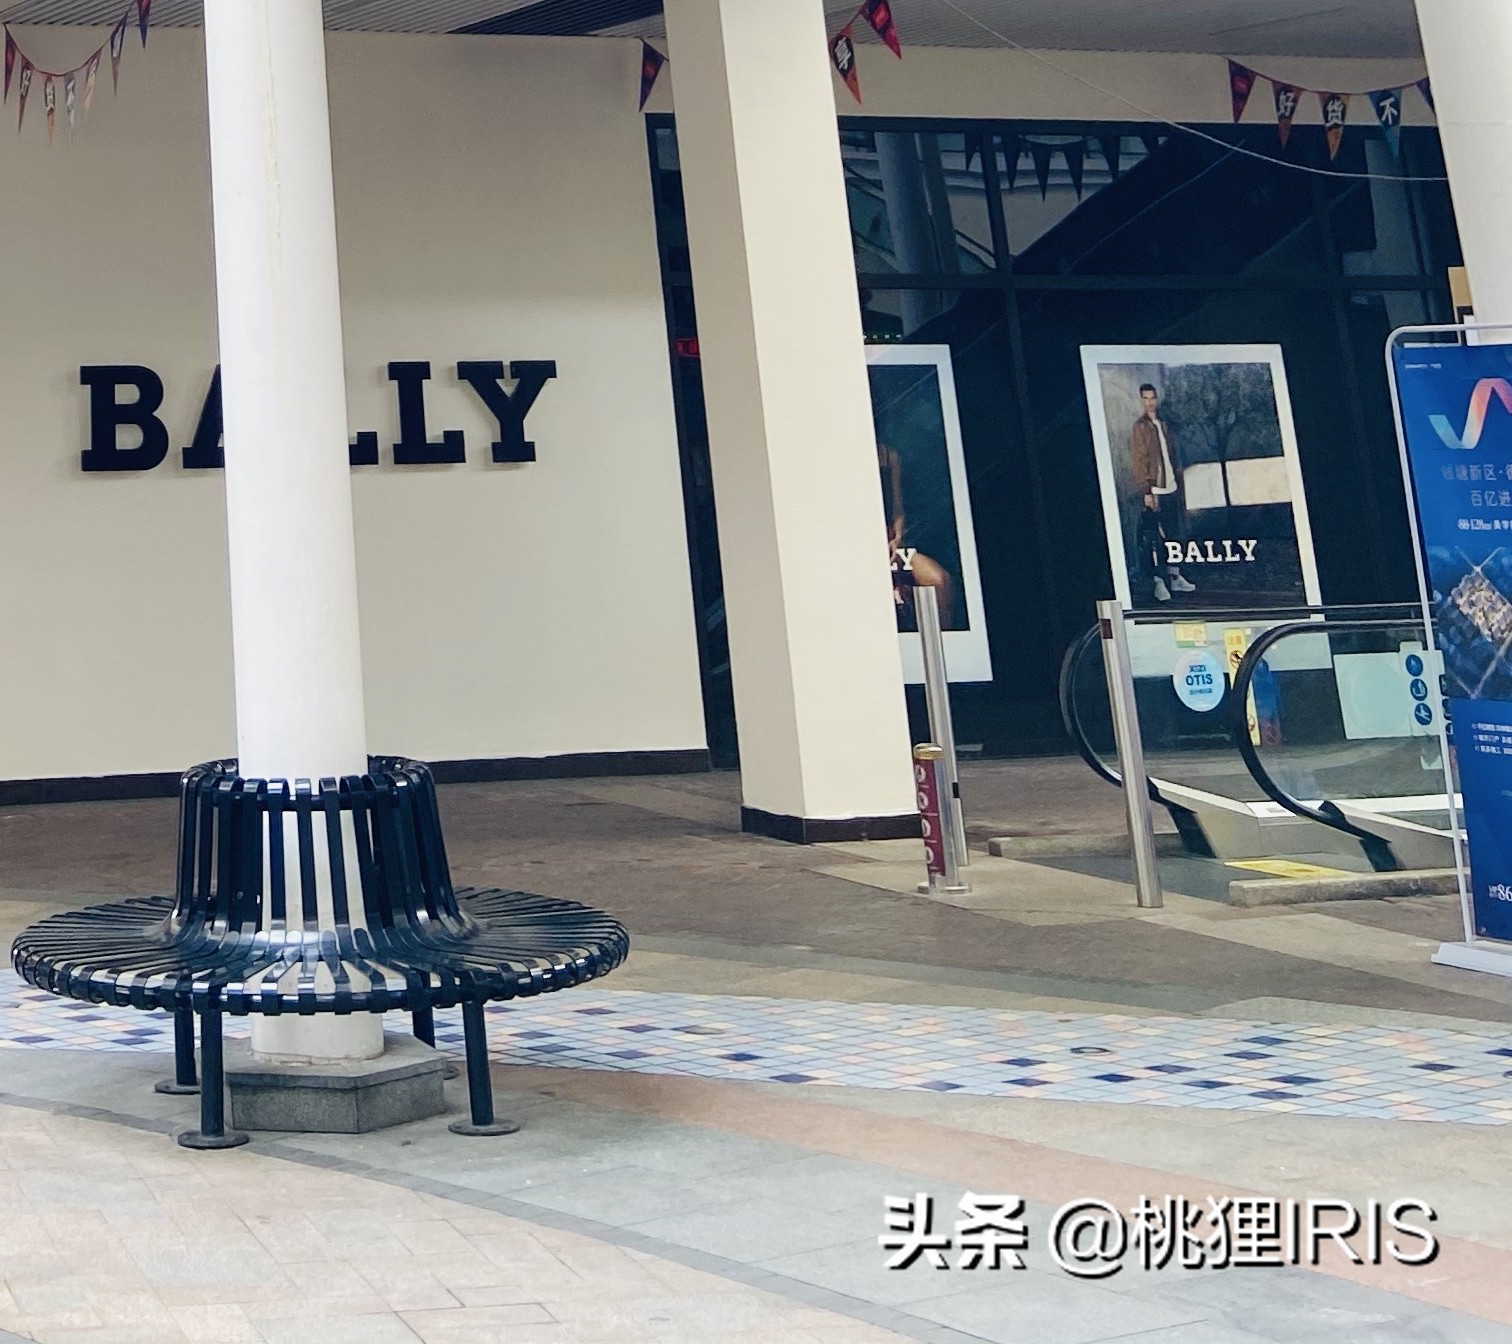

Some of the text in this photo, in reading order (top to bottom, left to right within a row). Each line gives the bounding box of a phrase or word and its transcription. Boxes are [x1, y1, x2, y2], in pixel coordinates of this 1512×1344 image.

[80, 361, 557, 471] BLY
[1165, 539, 1258, 564] BALLY
[1186, 674, 1213, 686] OTIS
